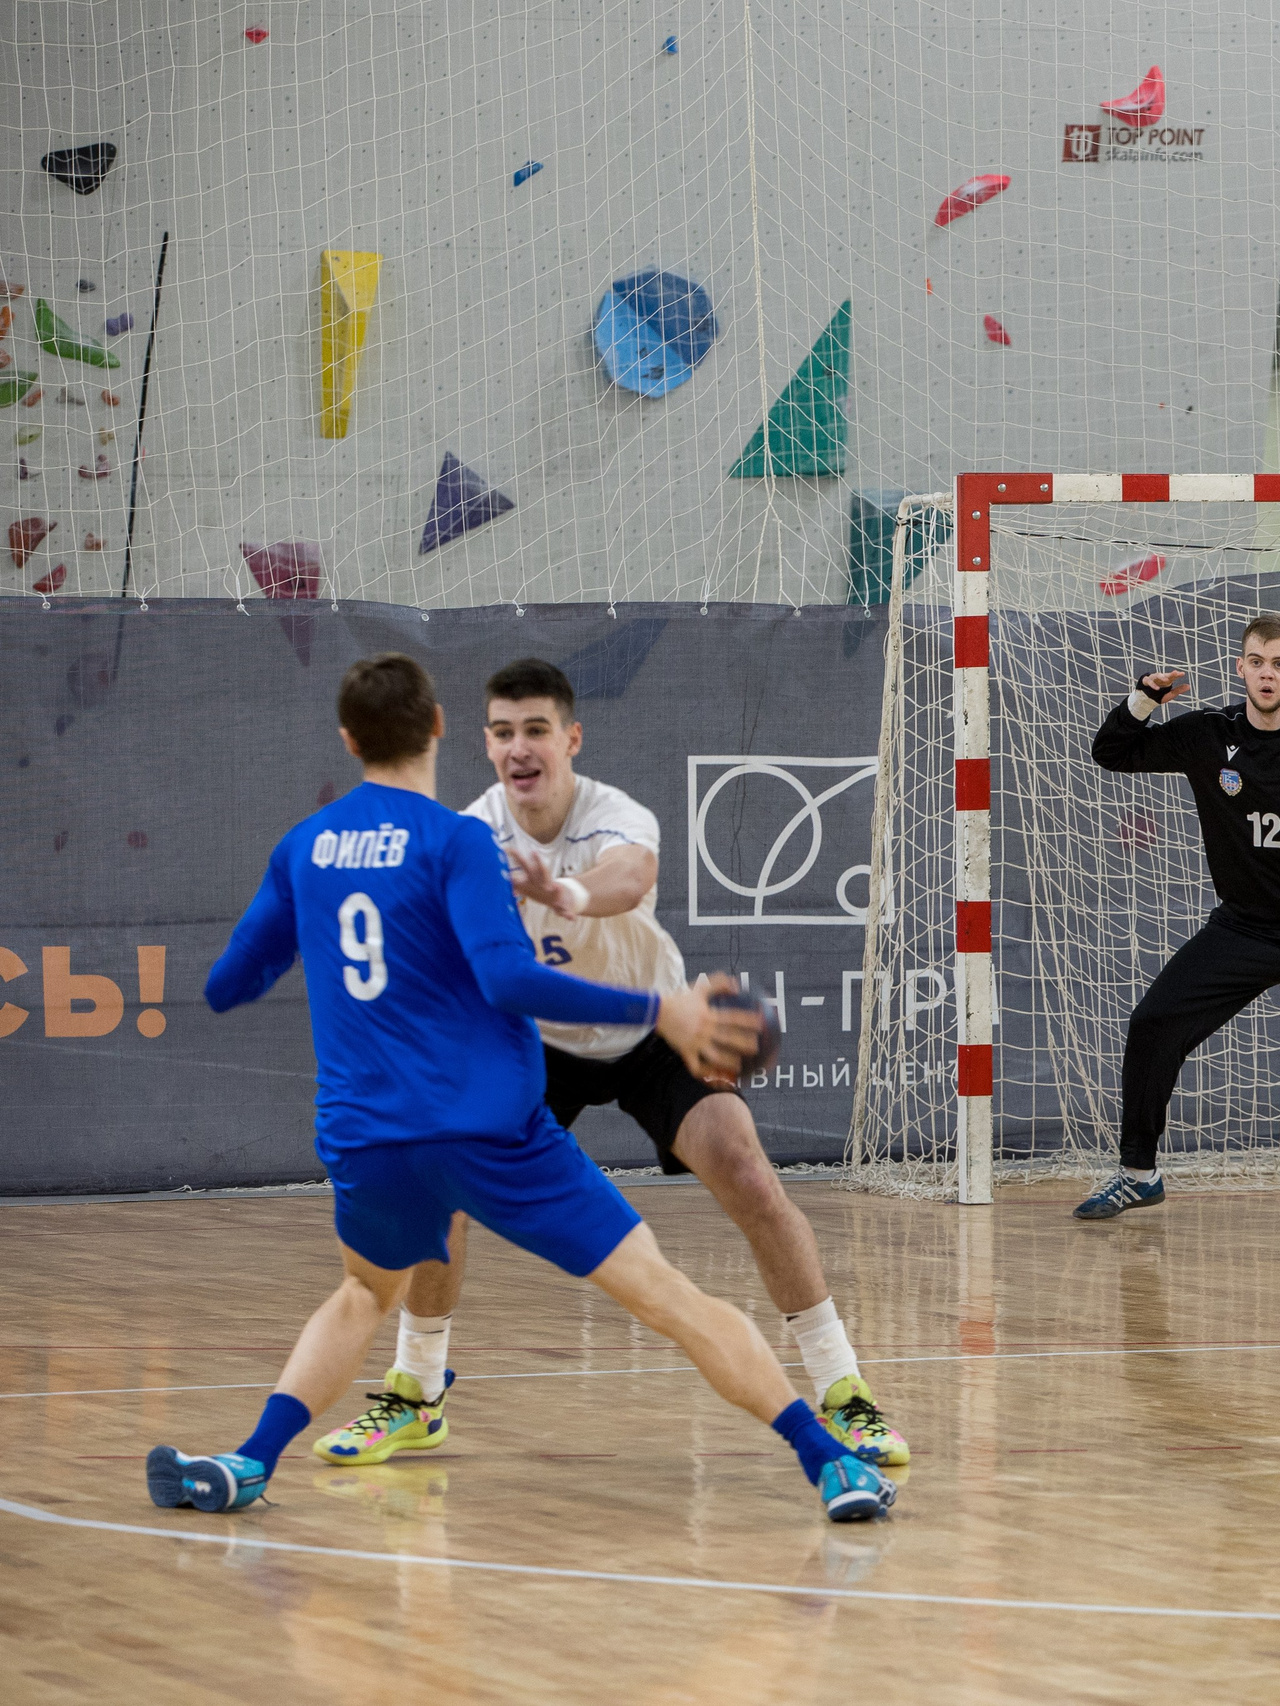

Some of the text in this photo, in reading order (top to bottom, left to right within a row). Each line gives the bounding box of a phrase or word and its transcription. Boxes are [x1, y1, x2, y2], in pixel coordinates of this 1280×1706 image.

[1107, 127, 1205, 146] TOP POINT
[311, 822, 410, 869] ФИЛЁВ
[338, 892, 388, 1001] 9
[541, 935, 573, 966] 5
[737, 1057, 850, 1089] ВНЫЙ
